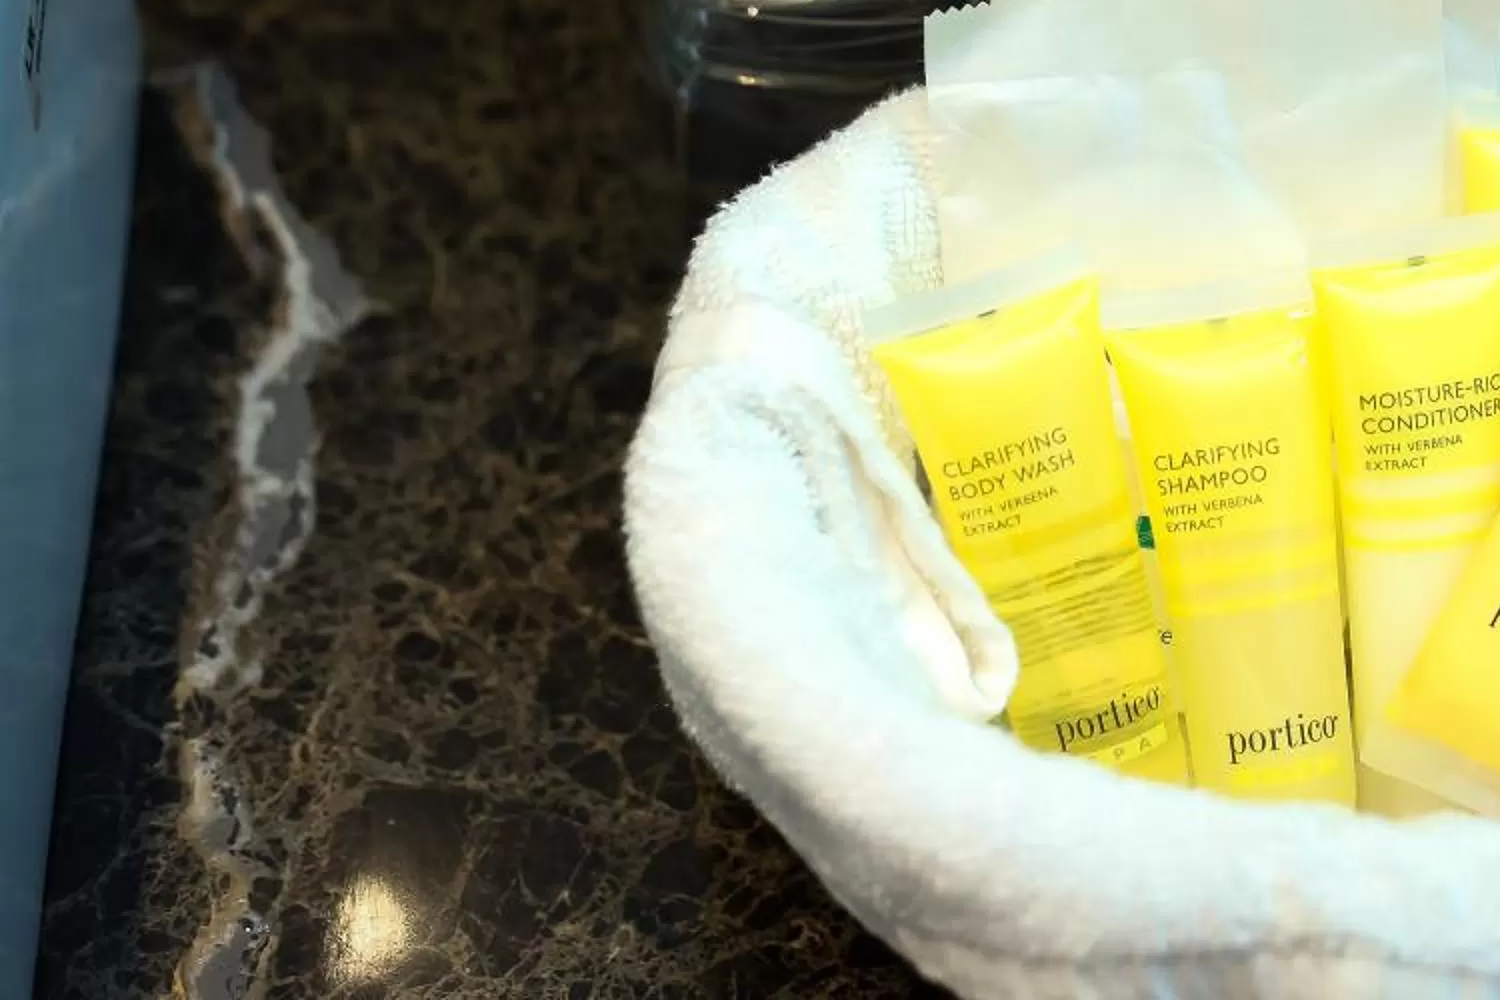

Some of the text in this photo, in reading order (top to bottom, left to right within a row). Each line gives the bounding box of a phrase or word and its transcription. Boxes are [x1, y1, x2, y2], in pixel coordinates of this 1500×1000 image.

[942, 426, 1068, 479] CLARIFYING
[1153, 437, 1281, 472] CLARIFYING
[1364, 434, 1464, 456] WITH VERBENA
[948, 448, 1076, 502] BODY WASH
[1365, 455, 1428, 472] EXTRACT
[1156, 465, 1268, 496] SHAMPOO
[959, 485, 1059, 521] WITH VERBENA
[1163, 493, 1264, 518] WITH VERBENA
[962, 514, 1022, 538] EXTRACT
[1165, 516, 1225, 533] EXTRACT
[1055, 686, 1160, 752] portico
[1227, 713, 1338, 765] portico
